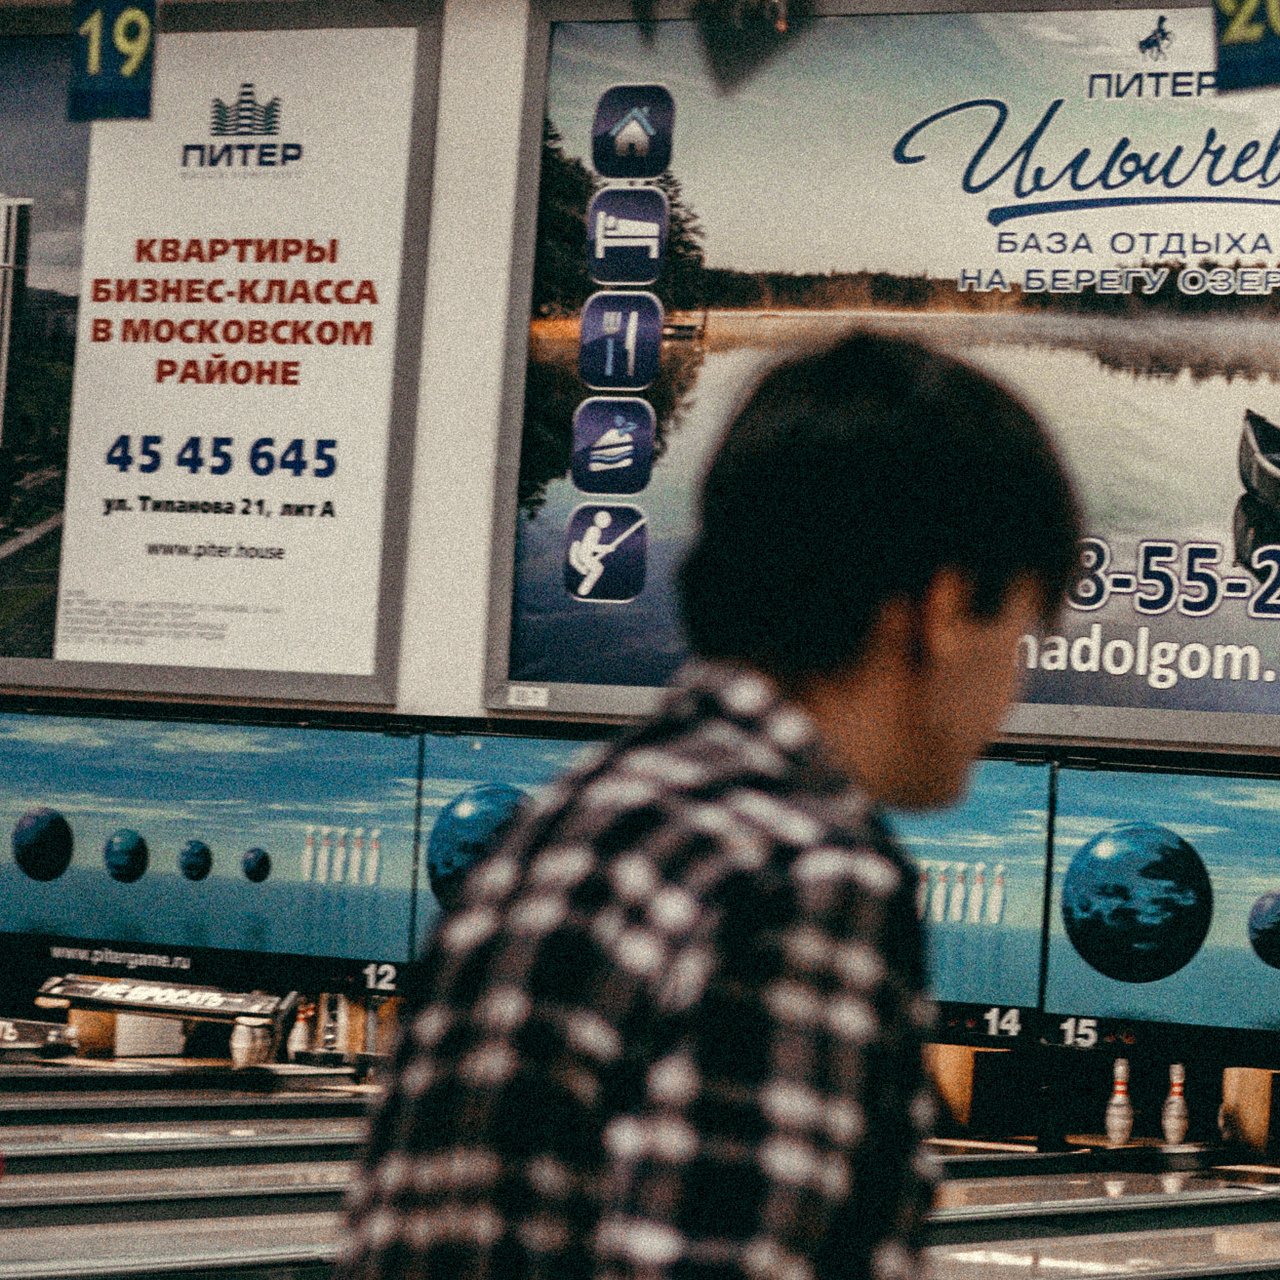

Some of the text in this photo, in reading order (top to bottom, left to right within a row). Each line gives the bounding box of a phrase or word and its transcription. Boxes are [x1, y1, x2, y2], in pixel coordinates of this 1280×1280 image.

[78, 6, 151, 77] 19
[181, 143, 304, 167] ПИТЕР
[134, 238, 339, 263] КВАРТИРЫ
[997, 231, 1273, 258] БАЗА ОТДЫХА
[91, 278, 379, 304] БИЗНЕС-КЛАССА
[958, 267, 1011, 293] НА
[1022, 267, 1170, 296] БЕРЕГУ
[91, 319, 373, 345] В МОСКОВСКОМ
[155, 353, 301, 385] РАЙОНЕ
[106, 434, 338, 479] 45 45 645
[102, 497, 132, 516] ул.
[138, 495, 235, 515] Типанова
[240, 498, 271, 517] 21,
[319, 501, 336, 518] А
[147, 542, 286, 560] www.piter.house
[50, 947, 192, 970] www.pitergame.ru
[363, 963, 397, 991] 12
[984, 1007, 1021, 1036] 14
[1059, 1017, 1098, 1048] 15
